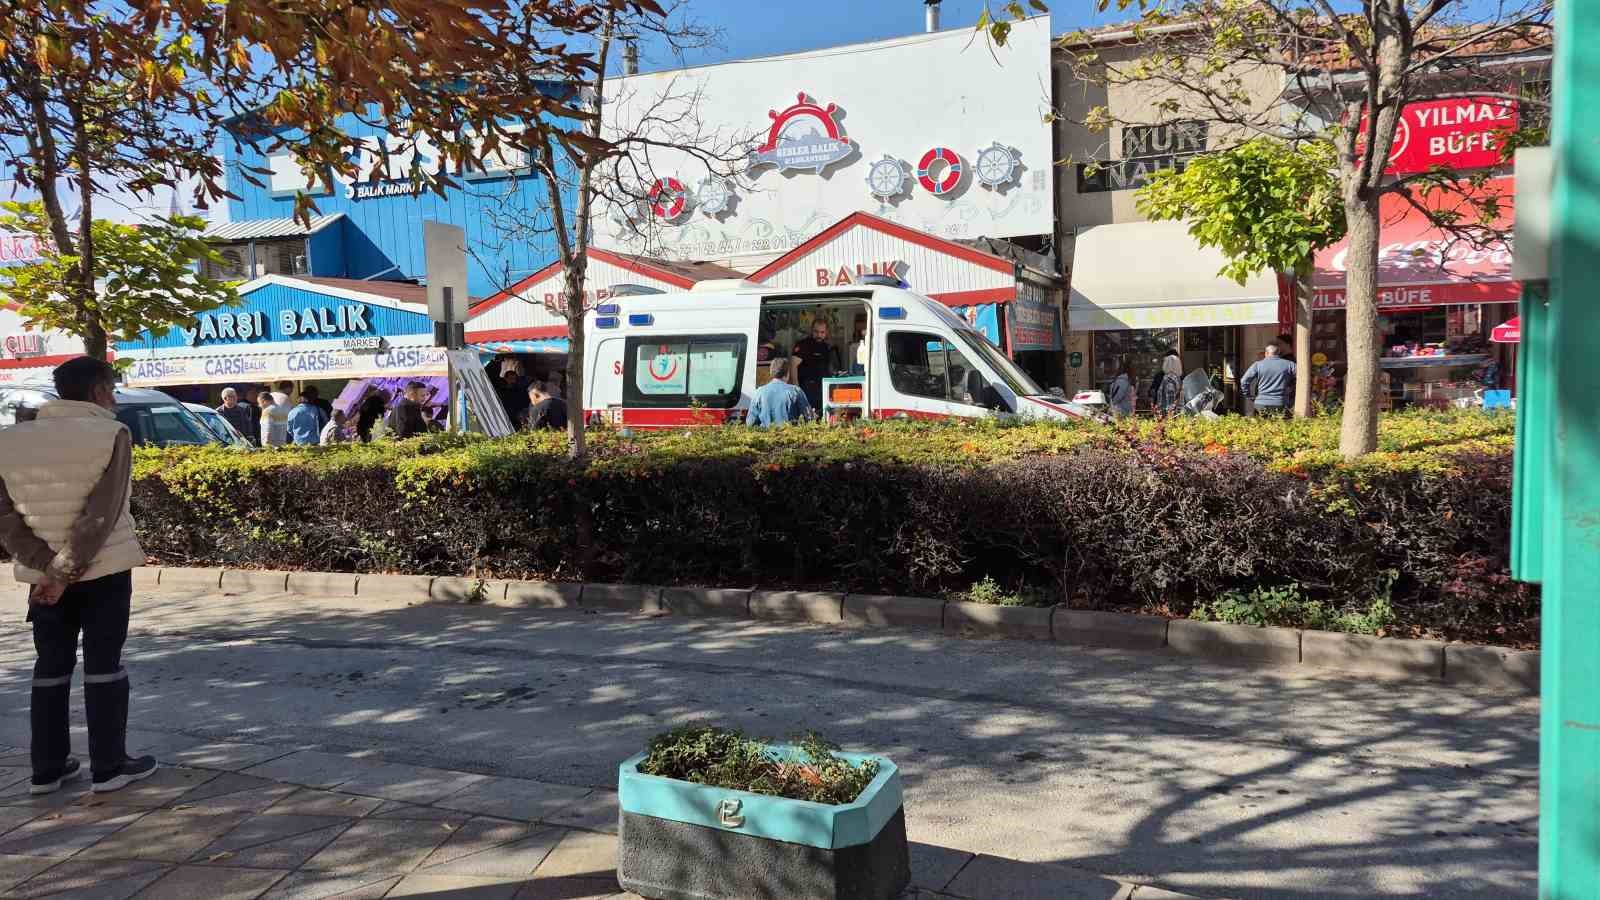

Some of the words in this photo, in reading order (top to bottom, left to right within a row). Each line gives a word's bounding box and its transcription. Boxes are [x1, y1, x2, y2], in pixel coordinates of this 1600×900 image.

[1416, 99, 1511, 127] YILMAZ
[1430, 131, 1496, 156] BÜFE
[386, 181, 426, 194] MARKT
[1382, 288, 1432, 304] BÜFE
[280, 304, 367, 335] BALIK
[344, 338, 380, 349] MARKET
